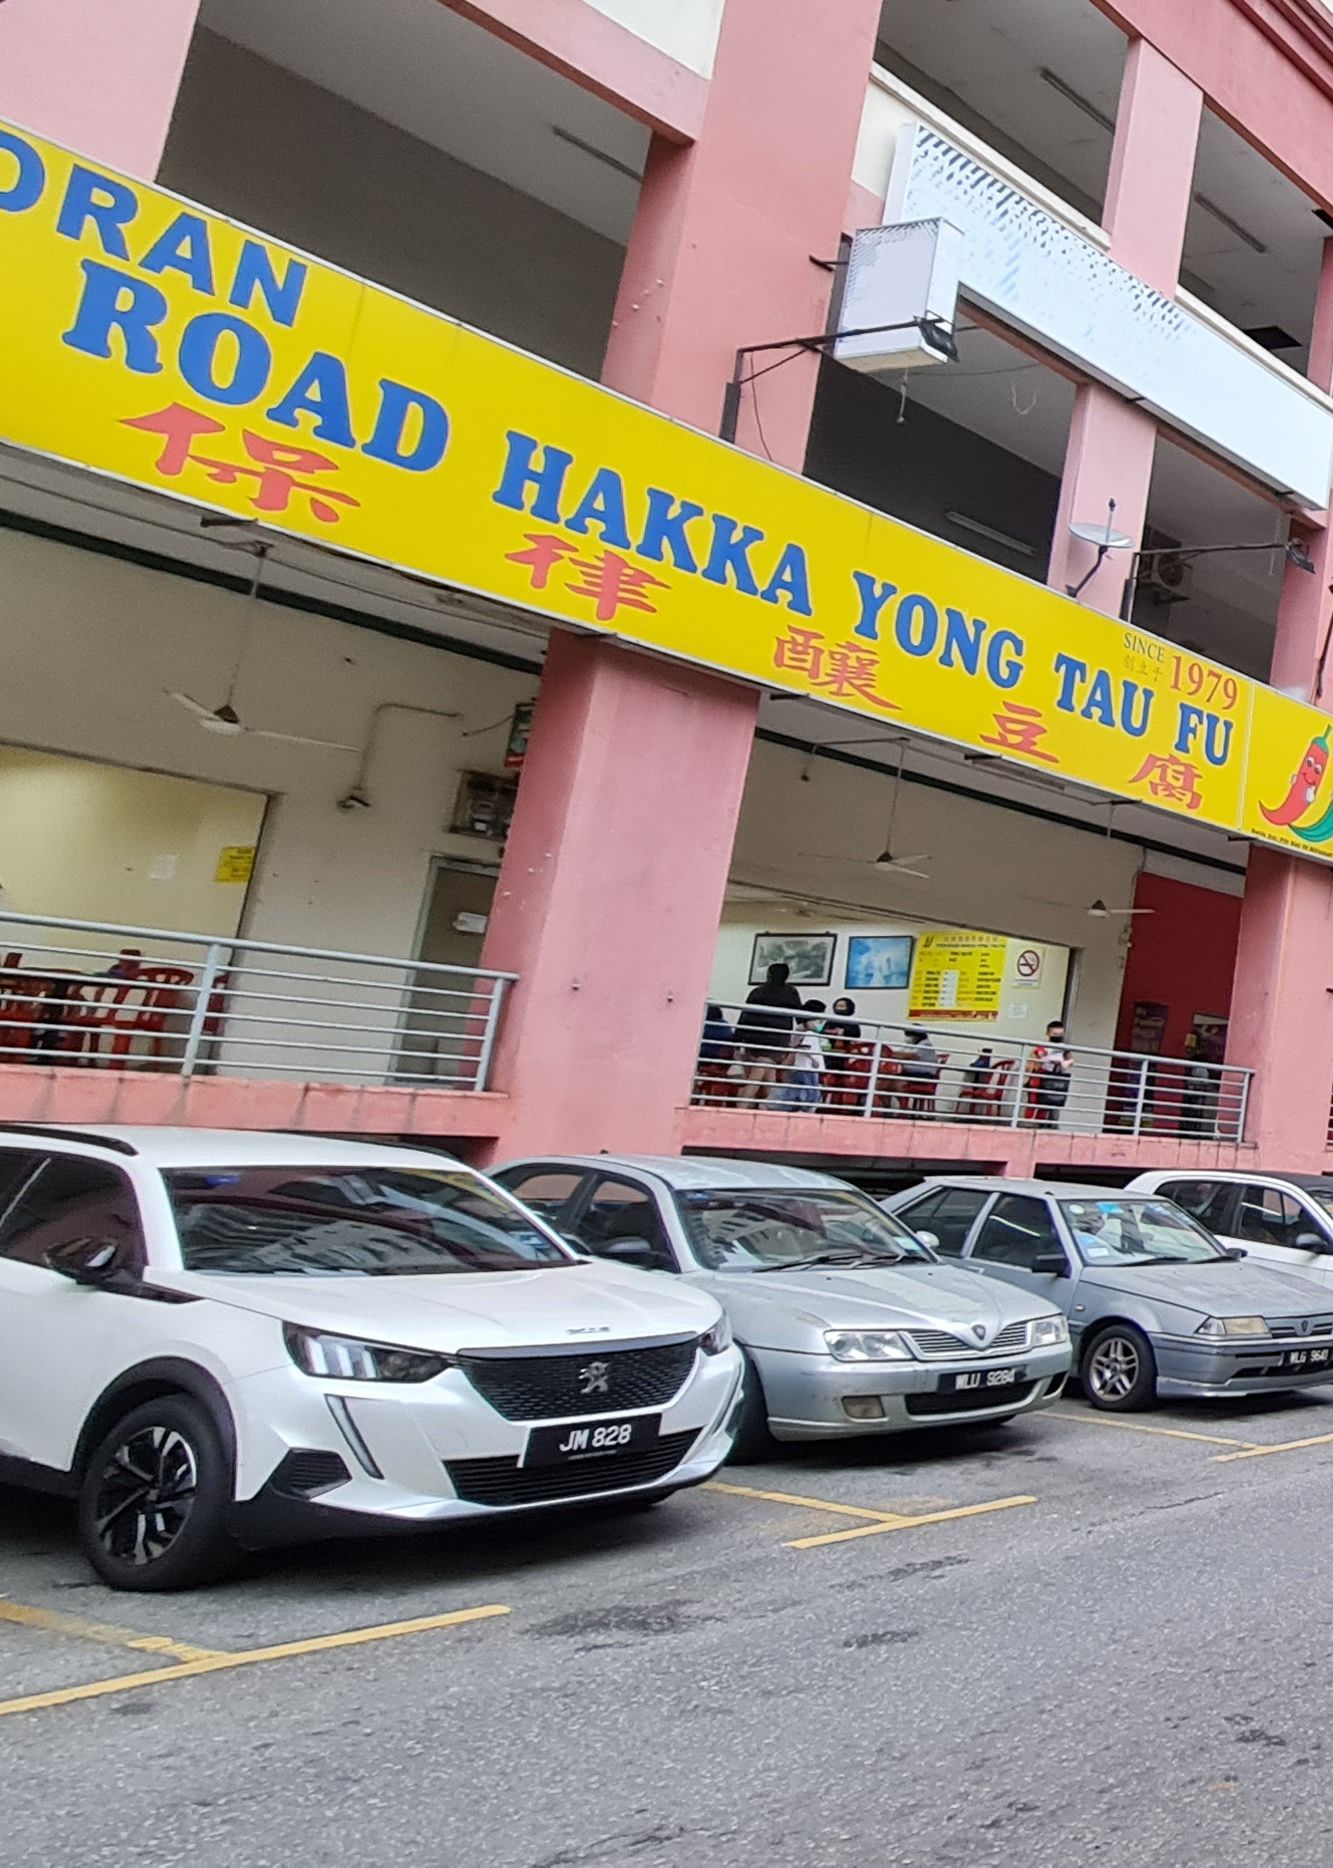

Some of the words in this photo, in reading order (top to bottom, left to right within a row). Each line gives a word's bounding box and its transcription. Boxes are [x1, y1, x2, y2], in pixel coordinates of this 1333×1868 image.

[62, 258, 450, 472] ROAD
[491, 430, 812, 617] HAKKA
[852, 570, 1024, 688] YONG
[1054, 653, 1155, 737] TAU
[1174, 702, 1235, 766] FU
[1123, 632, 1165, 663] SINCE
[1170, 655, 1238, 711] 1979
[955, 1372, 980, 1391] WLU
[986, 1368, 1016, 1386] 9284
[559, 1429, 590, 1452] JM
[592, 1423, 632, 1448] 828
